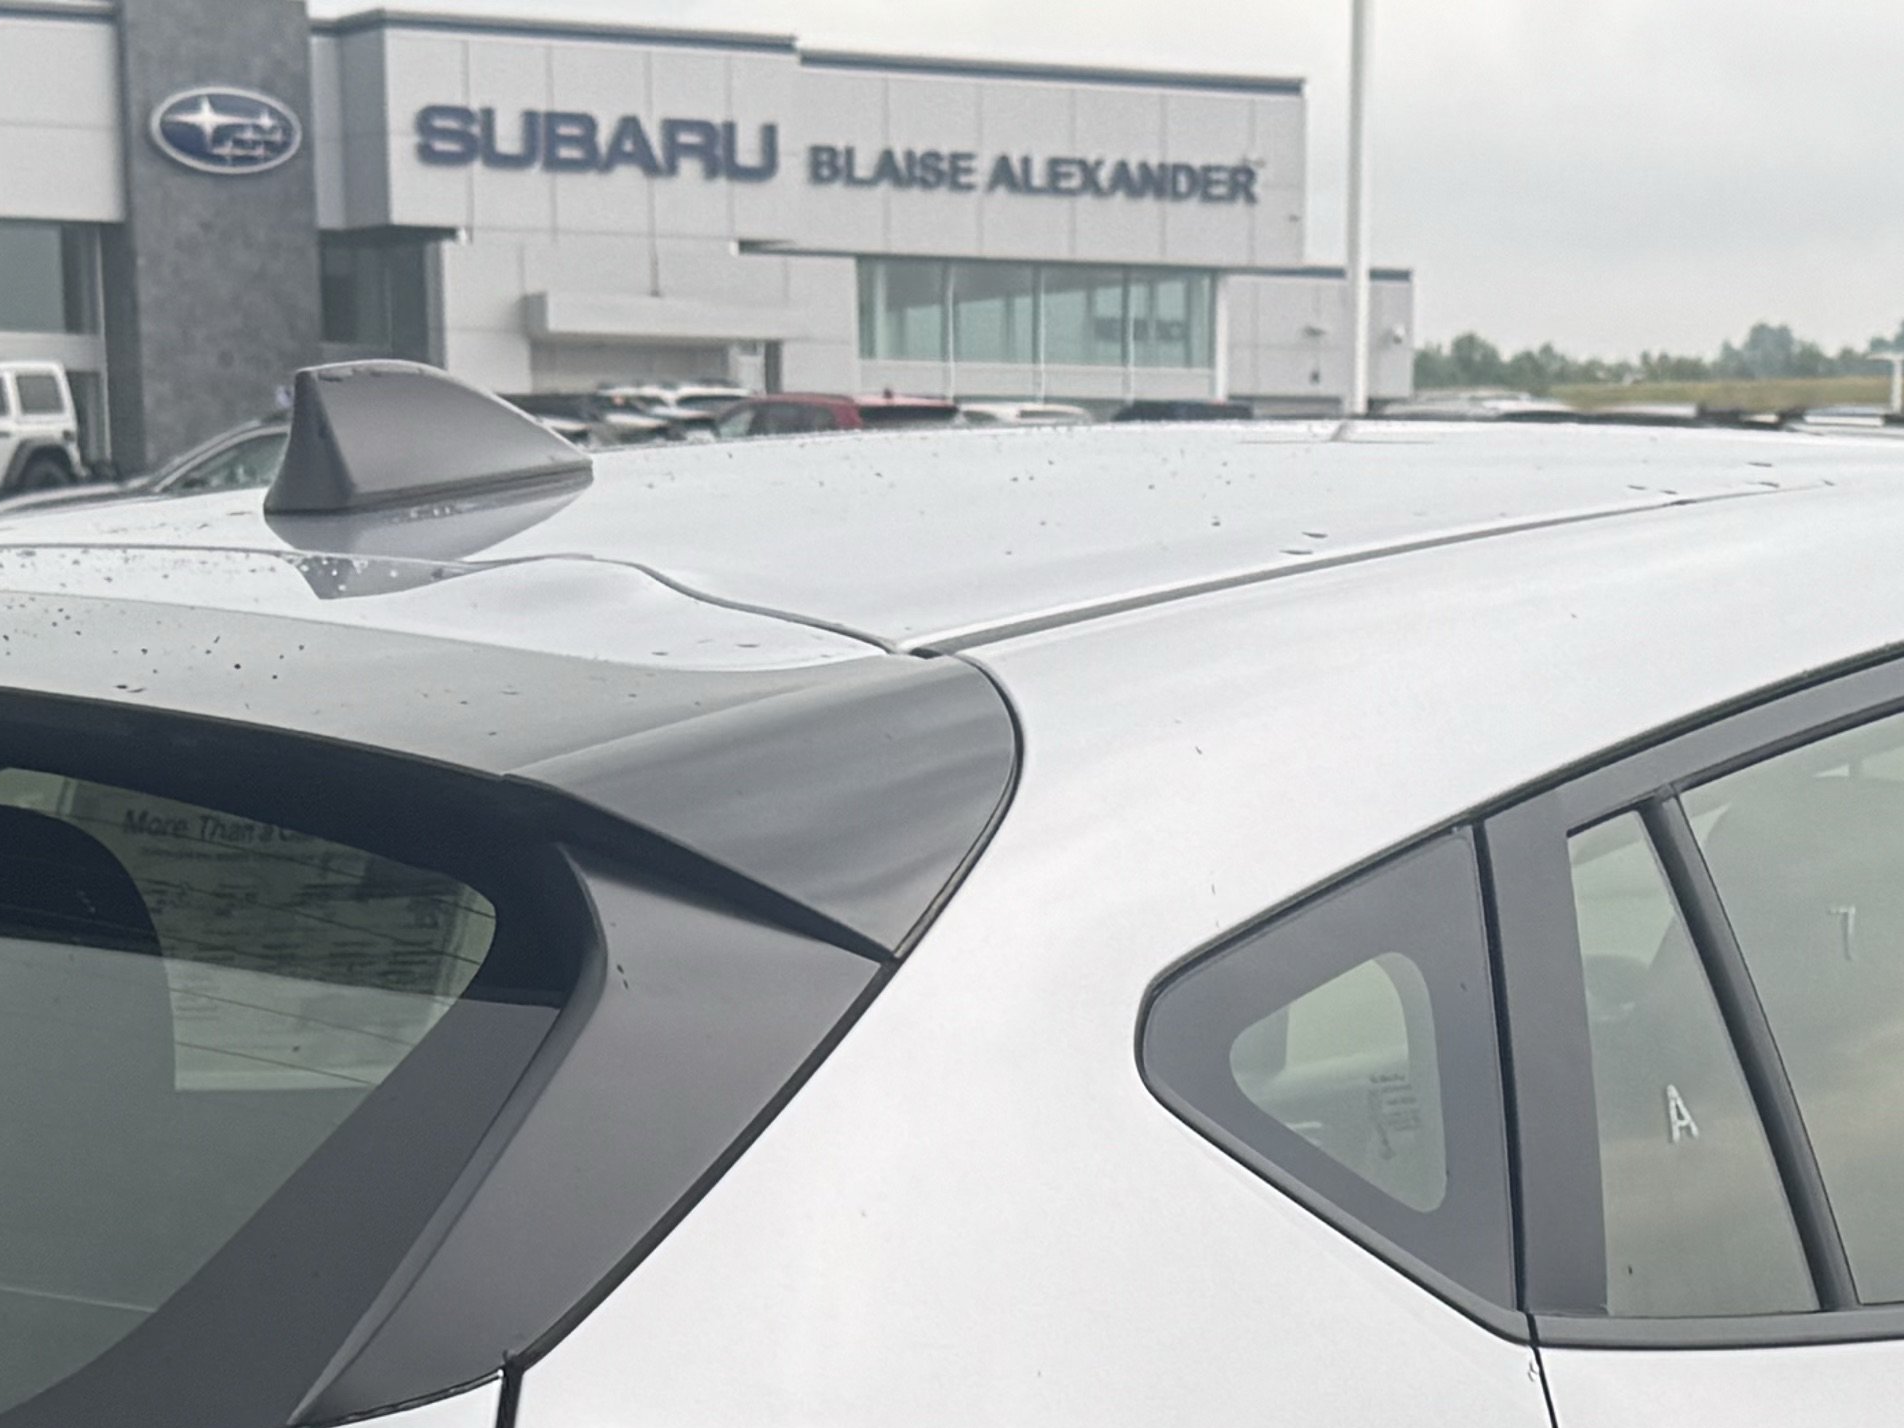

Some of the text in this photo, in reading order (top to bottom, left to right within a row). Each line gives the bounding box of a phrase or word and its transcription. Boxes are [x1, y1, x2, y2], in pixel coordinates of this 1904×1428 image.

[415, 104, 778, 183] SUBARU
[807, 144, 1258, 205] BLAISE ALEXANDER
[122, 808, 190, 836] More
[199, 814, 255, 843] Than
[1666, 1083, 1699, 1143] A
